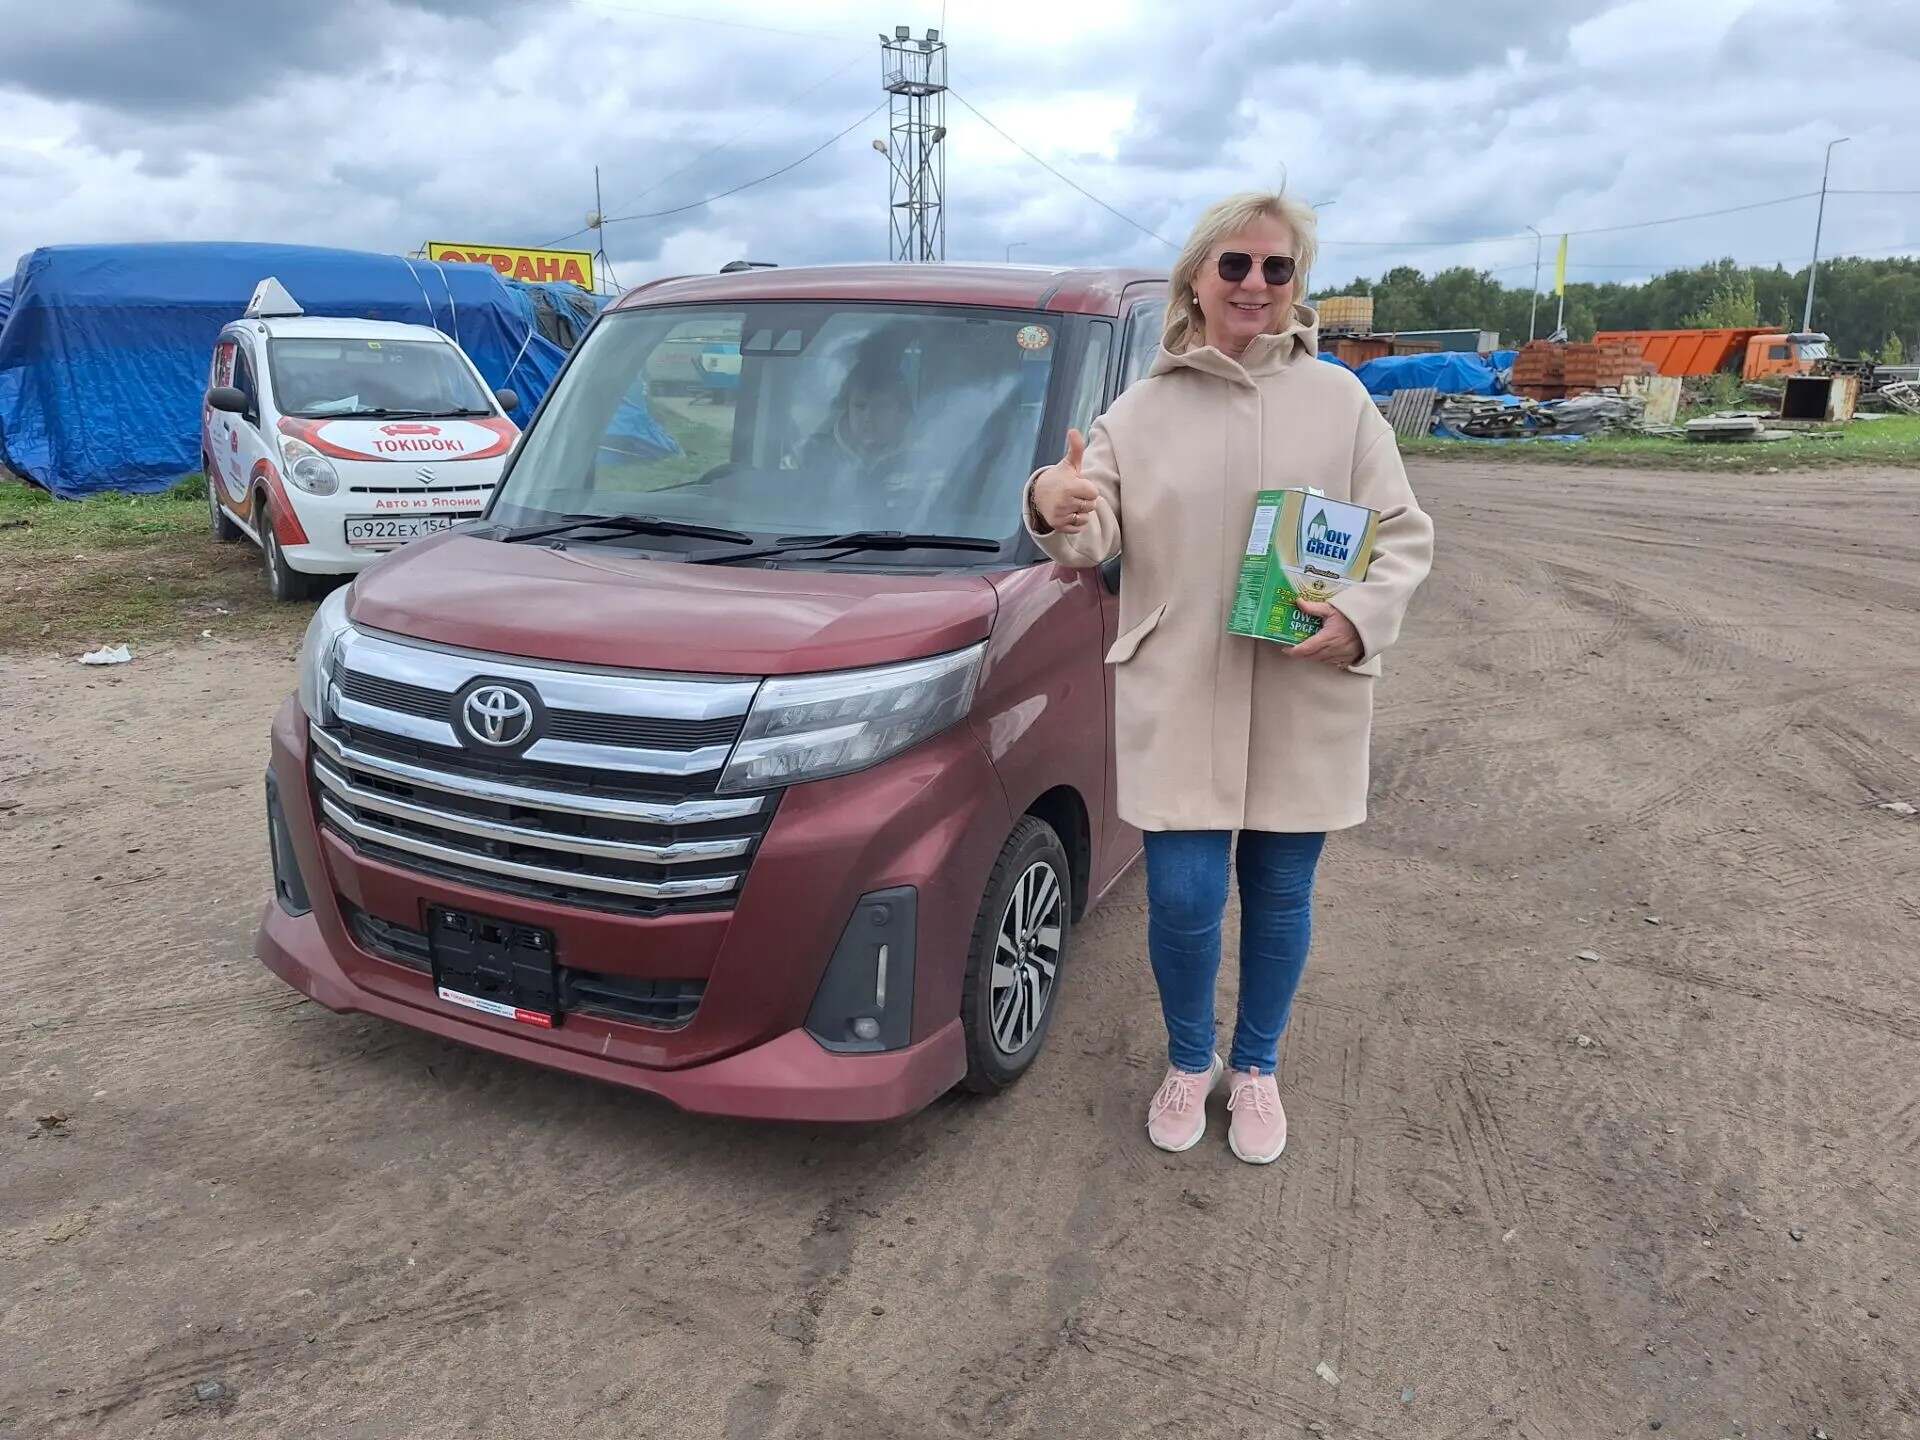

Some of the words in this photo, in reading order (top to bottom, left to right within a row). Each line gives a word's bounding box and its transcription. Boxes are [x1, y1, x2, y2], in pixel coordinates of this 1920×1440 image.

[372, 439, 465, 452] TOKIDOKI
[376, 499, 409, 509] Авто
[413, 500, 428, 508] из
[432, 497, 481, 507] Японии
[1309, 522, 1352, 545] MOLY
[1306, 540, 1349, 561] GREEN
